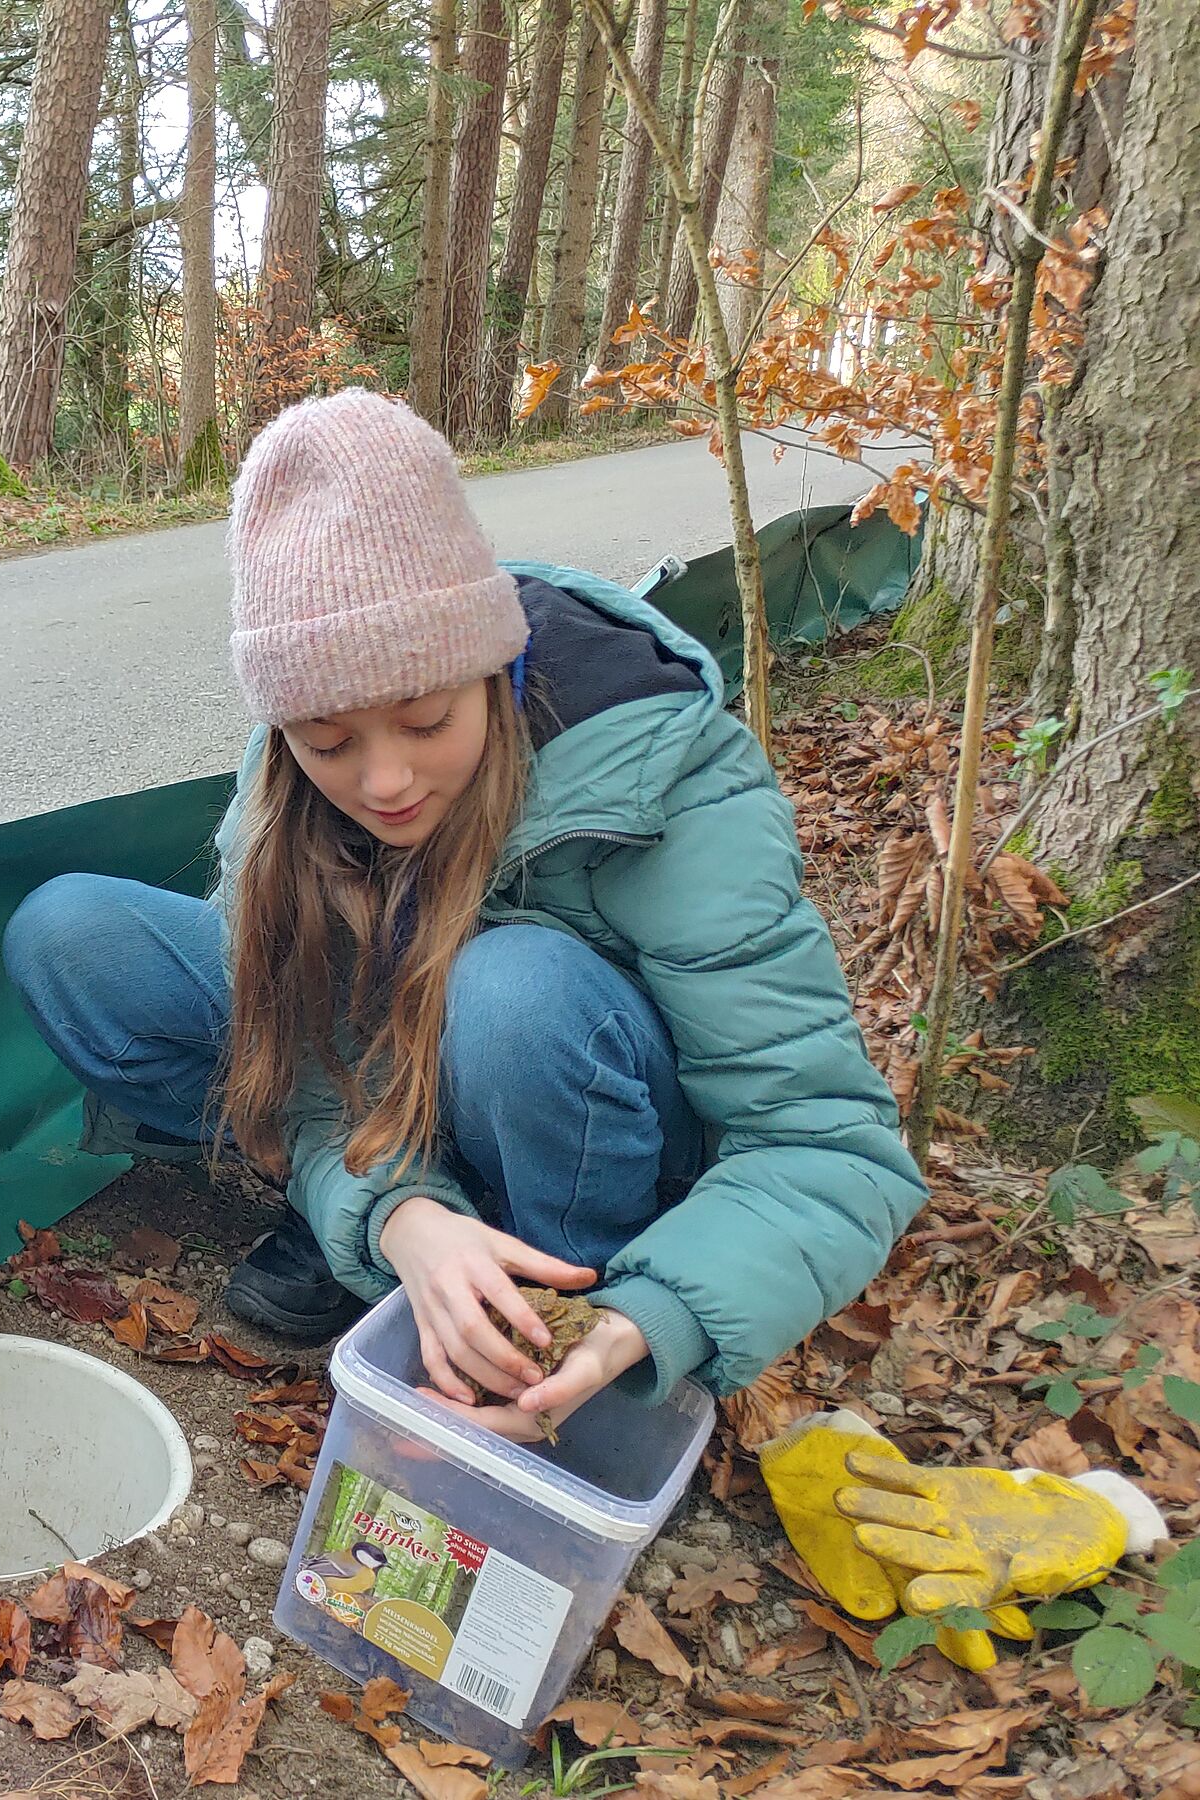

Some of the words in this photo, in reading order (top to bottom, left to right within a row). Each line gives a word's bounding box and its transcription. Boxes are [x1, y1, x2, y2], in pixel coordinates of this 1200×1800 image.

[352, 1511, 441, 1564] Pfiffikus
[451, 1533, 463, 1543] 30
[464, 1537, 487, 1556] Stück
[450, 1542, 467, 1555] ohne
[467, 1549, 483, 1563] Netz
[383, 1607, 438, 1643] MEISENKNÖDEL
